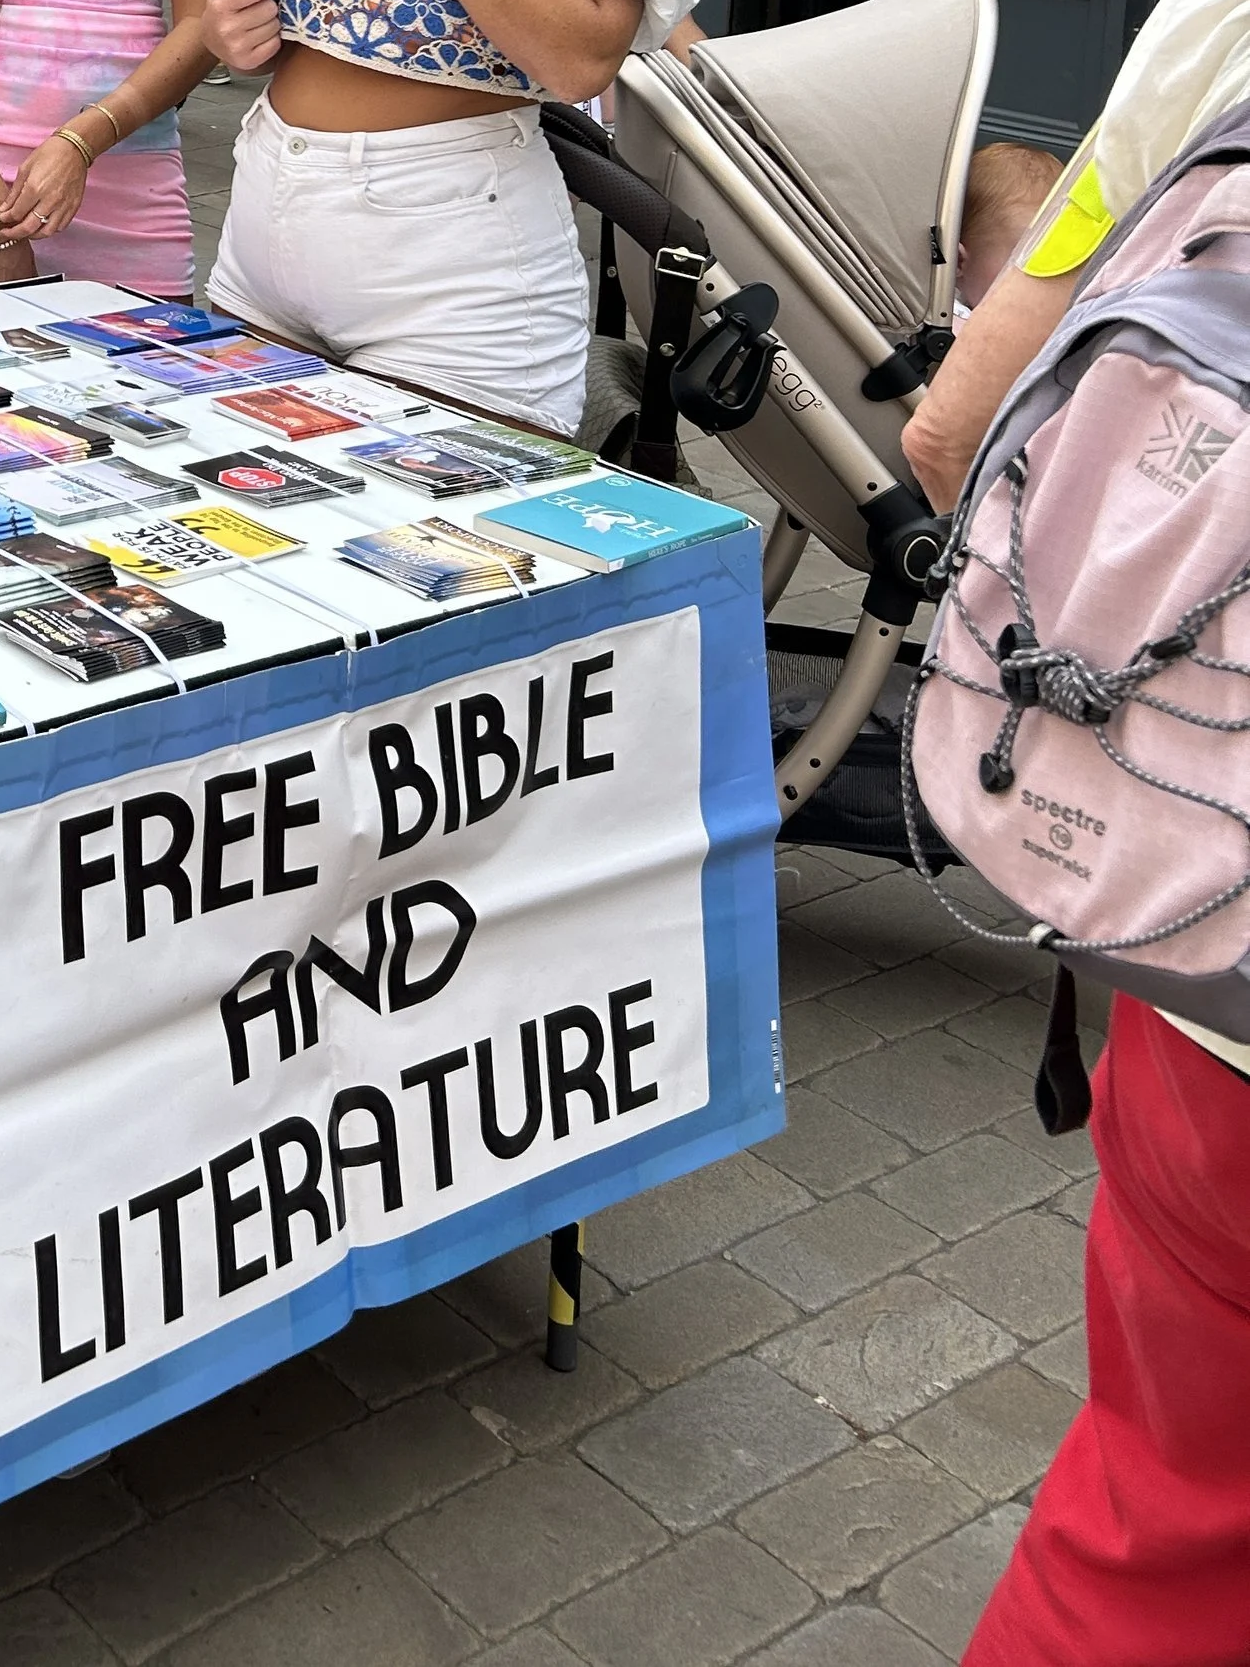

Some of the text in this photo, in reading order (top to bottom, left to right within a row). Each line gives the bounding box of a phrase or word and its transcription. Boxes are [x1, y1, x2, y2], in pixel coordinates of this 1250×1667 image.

[225, 469, 281, 487] STOP
[542, 493, 678, 538] HOPE
[107, 531, 142, 546] FOR
[122, 527, 215, 566] WEAK
[144, 522, 234, 561] PEOPLE
[149, 552, 192, 569] FAITH
[60, 650, 615, 965] FREE BIBLE
[1021, 789, 1106, 836] spectre
[220, 879, 477, 1086] AND
[34, 978, 658, 1383] LITERATURE
